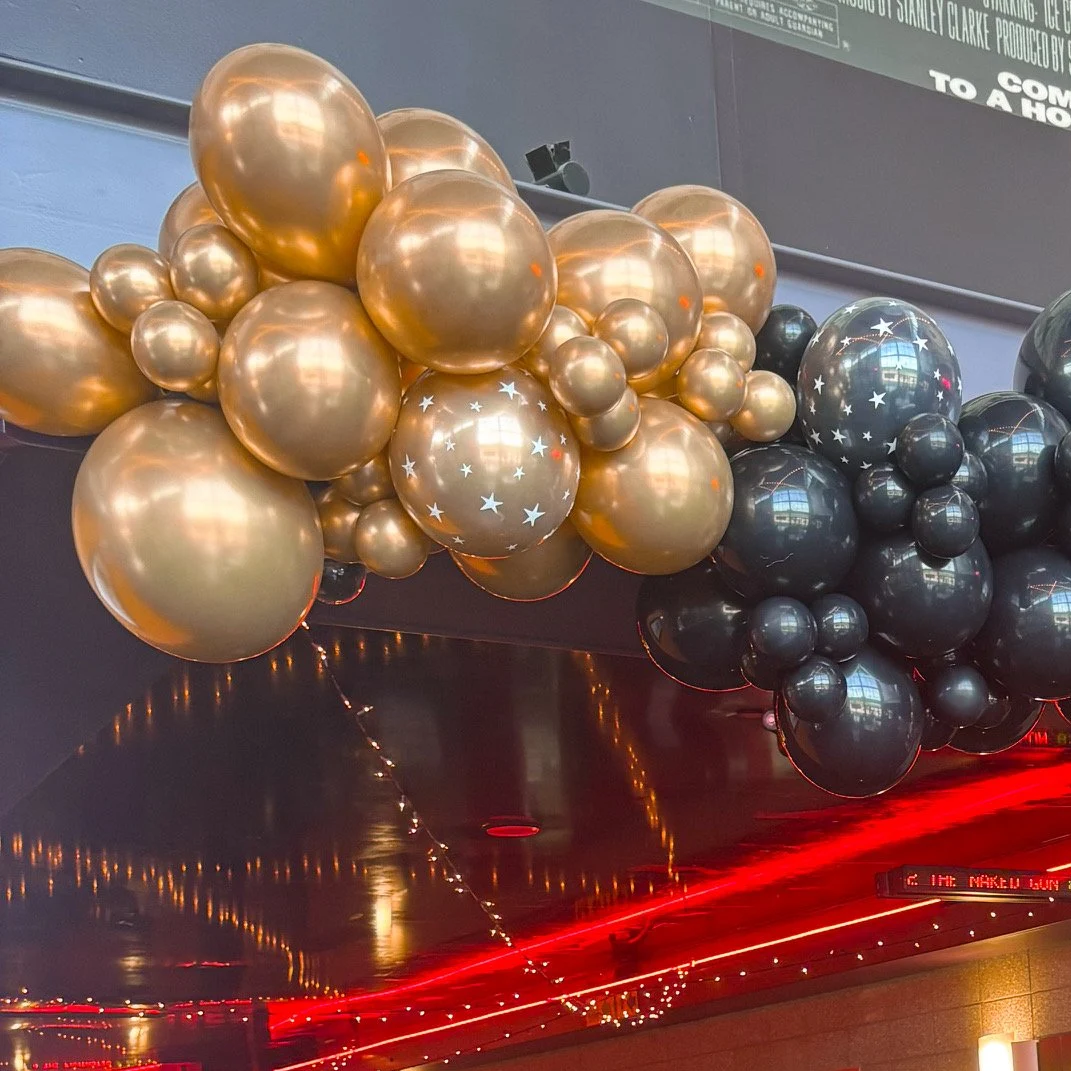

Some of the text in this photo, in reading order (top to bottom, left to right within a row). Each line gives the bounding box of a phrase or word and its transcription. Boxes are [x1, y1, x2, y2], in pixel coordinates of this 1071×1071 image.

[778, 7, 834, 32] ACCOMPANYING
[787, 19, 824, 39] GUARDIAN
[949, 3, 991, 51] CLARKE
[996, 17, 1049, 69] PRODUCED
[1051, 35, 1065, 73] BY
[929, 69, 977, 100] TO
[986, 89, 1012, 112] A
[969, 875, 1020, 890] NAKED
[1029, 878, 1060, 892] GUN
